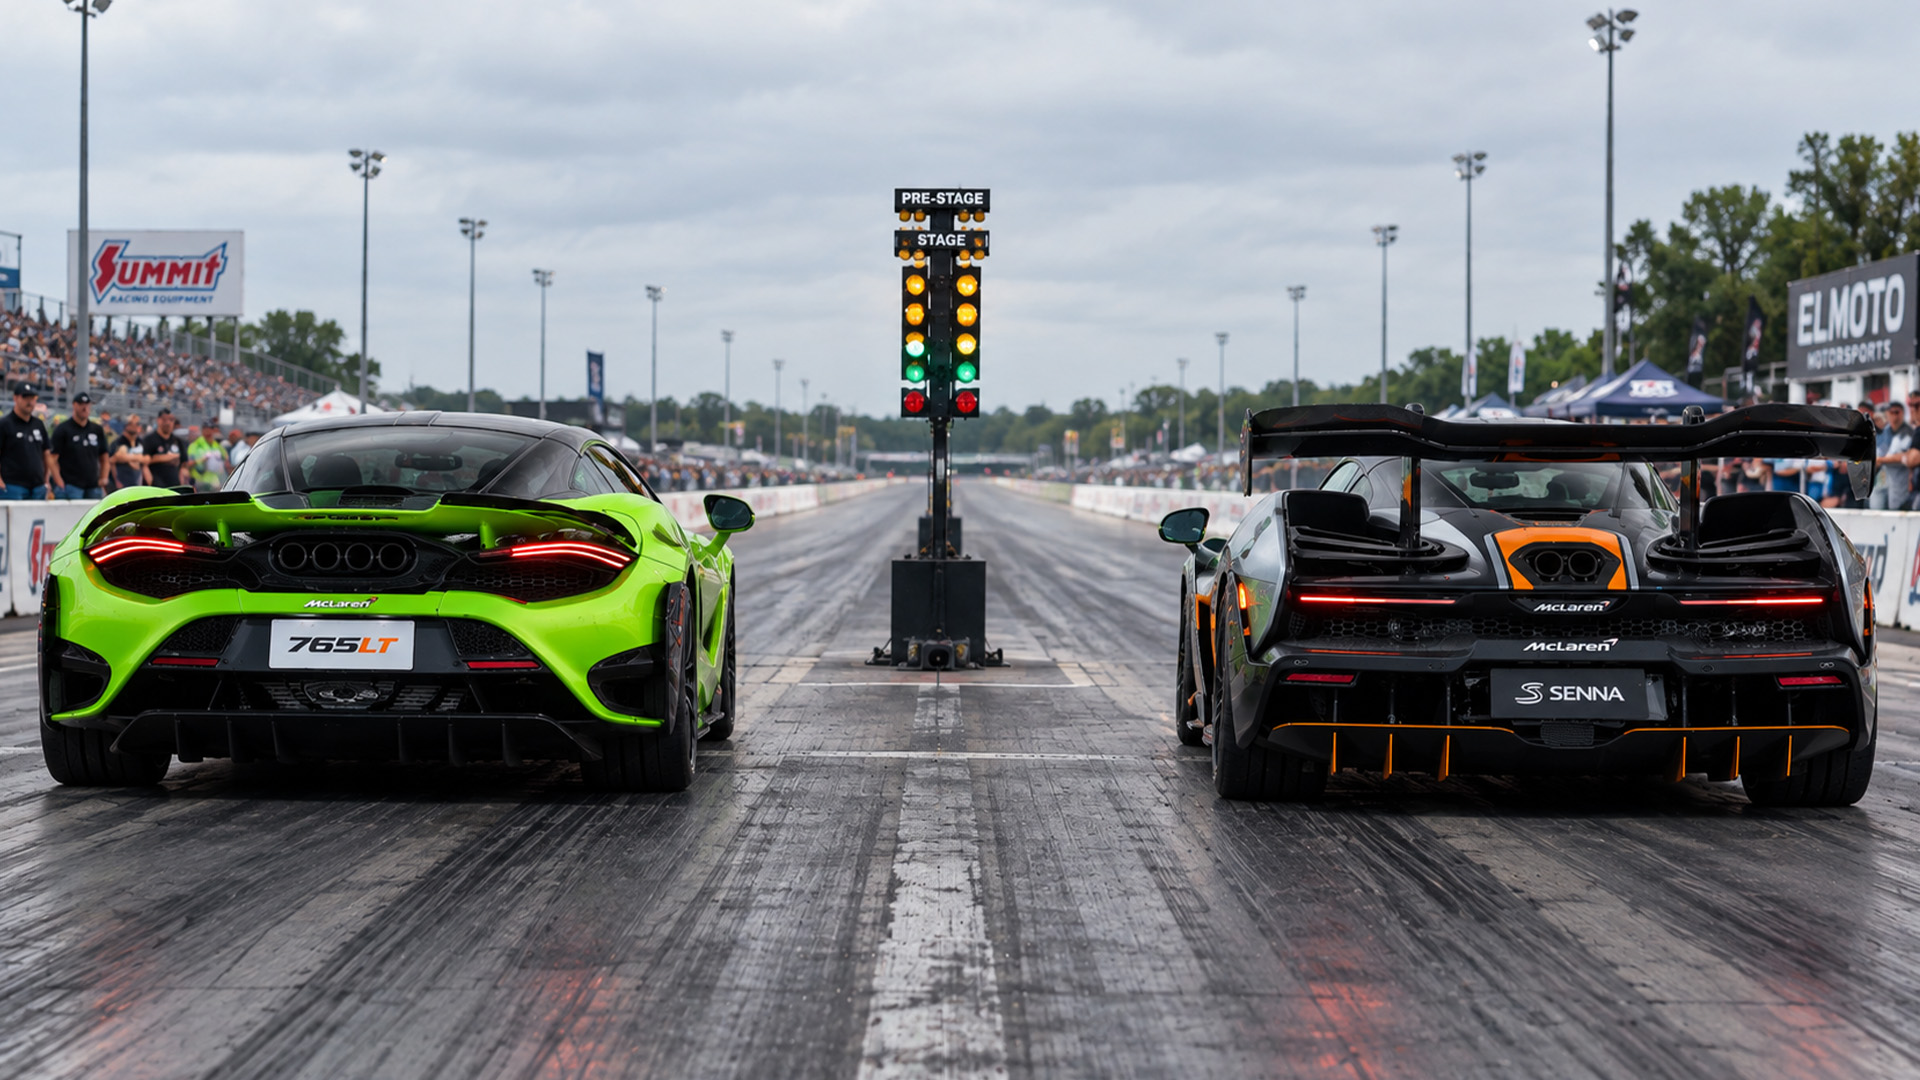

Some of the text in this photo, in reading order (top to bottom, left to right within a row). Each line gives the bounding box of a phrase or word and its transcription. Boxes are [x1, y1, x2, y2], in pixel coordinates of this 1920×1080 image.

[901, 192, 984, 205] PRE-STAGE
[917, 234, 966, 247] STAGE
[109, 294, 214, 304] RACING EQUIPMENT
[1796, 273, 1906, 347] ELMOTO
[1806, 338, 1892, 370] MOTORSPORTS
[303, 598, 373, 609] McLaren
[1533, 602, 1606, 612] McLaren
[288, 636, 400, 654] 765LT
[1522, 640, 1614, 652] McLaren
[1549, 685, 1625, 702] SENNA
